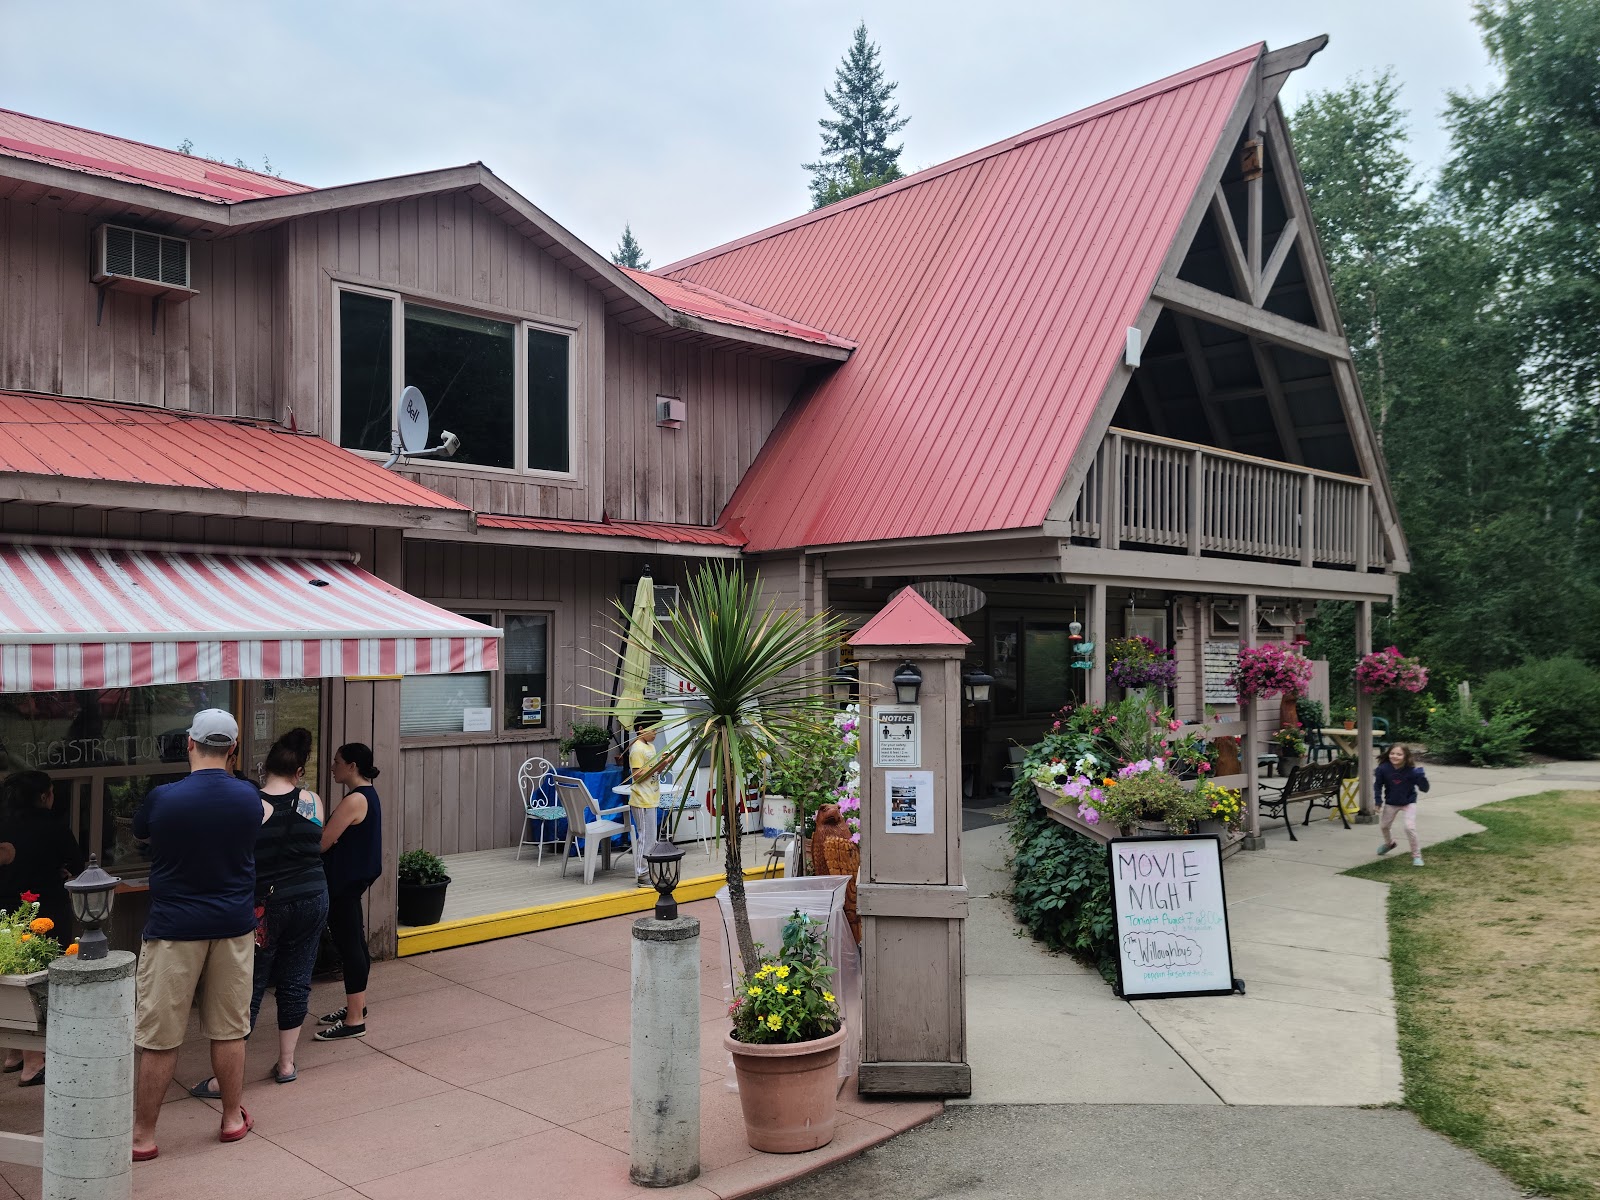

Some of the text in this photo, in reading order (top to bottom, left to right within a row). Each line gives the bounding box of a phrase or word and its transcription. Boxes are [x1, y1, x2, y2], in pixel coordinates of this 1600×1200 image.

[406, 399, 420, 423] Bell
[938, 599, 976, 609] RESORT
[944, 590, 965, 599] ARM
[22, 736, 166, 767] REGISTRATION
[1118, 851, 1200, 880] MOVIE
[1128, 881, 1198, 911] NIGHT
[1125, 914, 1159, 932] Tonight
[1161, 913, 1185, 932] August
[1138, 938, 1192, 969] Willoughbys
[1143, 971, 1166, 982] popcorn
